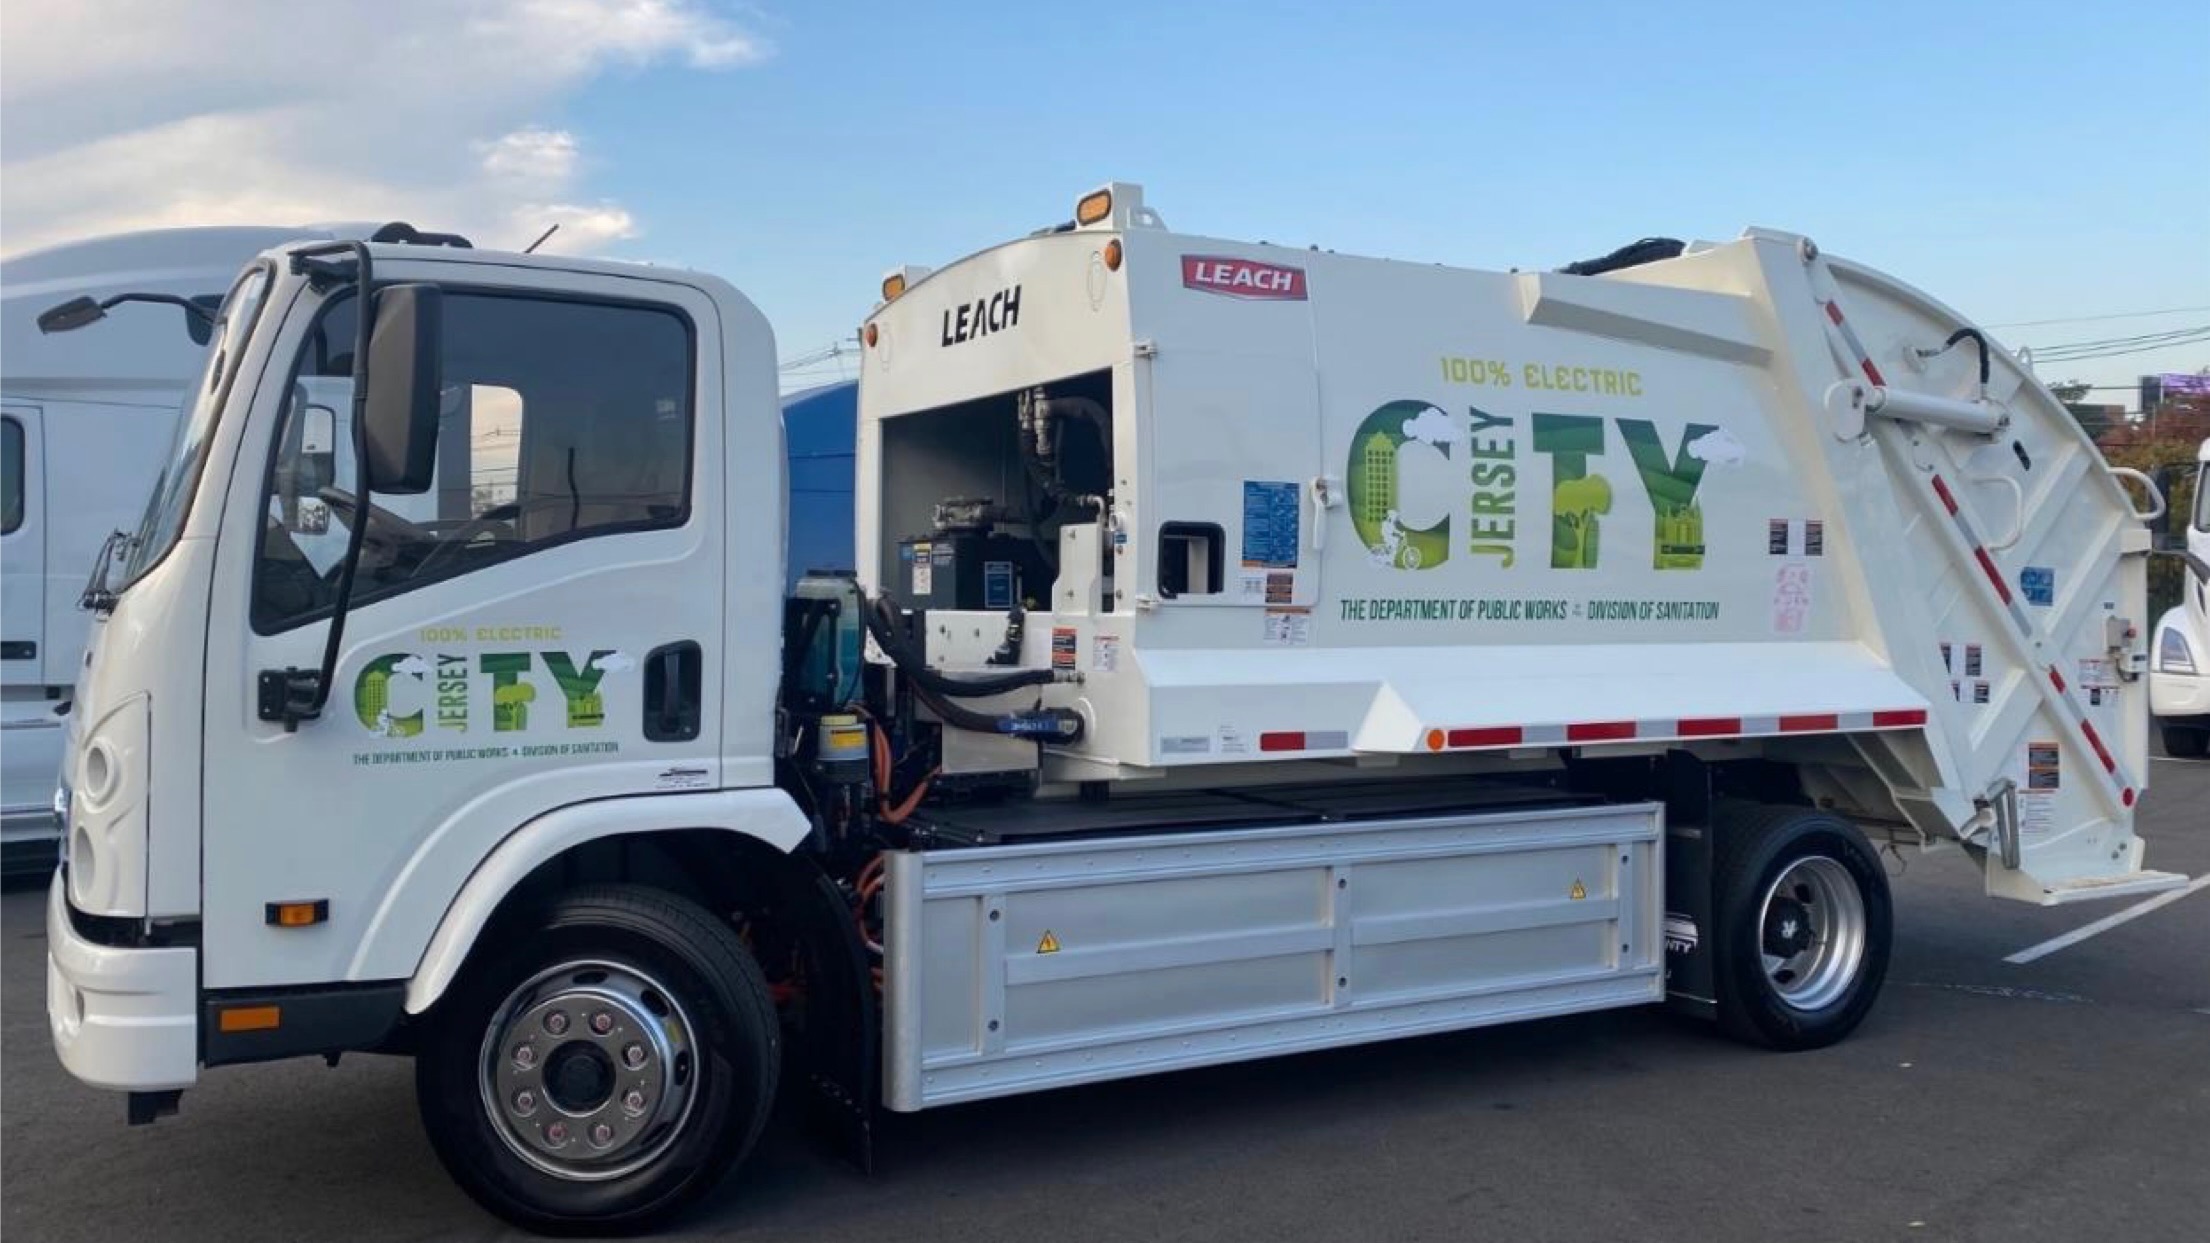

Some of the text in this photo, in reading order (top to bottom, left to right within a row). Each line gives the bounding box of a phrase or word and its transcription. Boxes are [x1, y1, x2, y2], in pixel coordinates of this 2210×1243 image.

[1195, 261, 1293, 292] LEACH
[941, 284, 1022, 348] LEACH
[1441, 357, 1644, 396] 100% ELECTRIC
[1469, 406, 1516, 568] JERSEY
[1340, 599, 1720, 621] THE DEPARTMENT OF PUBLIC WORKS DIVISION OF SANITATION
[420, 626, 562, 643] 100% ELECTRIC
[437, 653, 468, 734] JERSEY
[353, 742, 619, 766] THE DEPARTMENT OF PUBLIC WORKS DIVISION OF SANITATION
